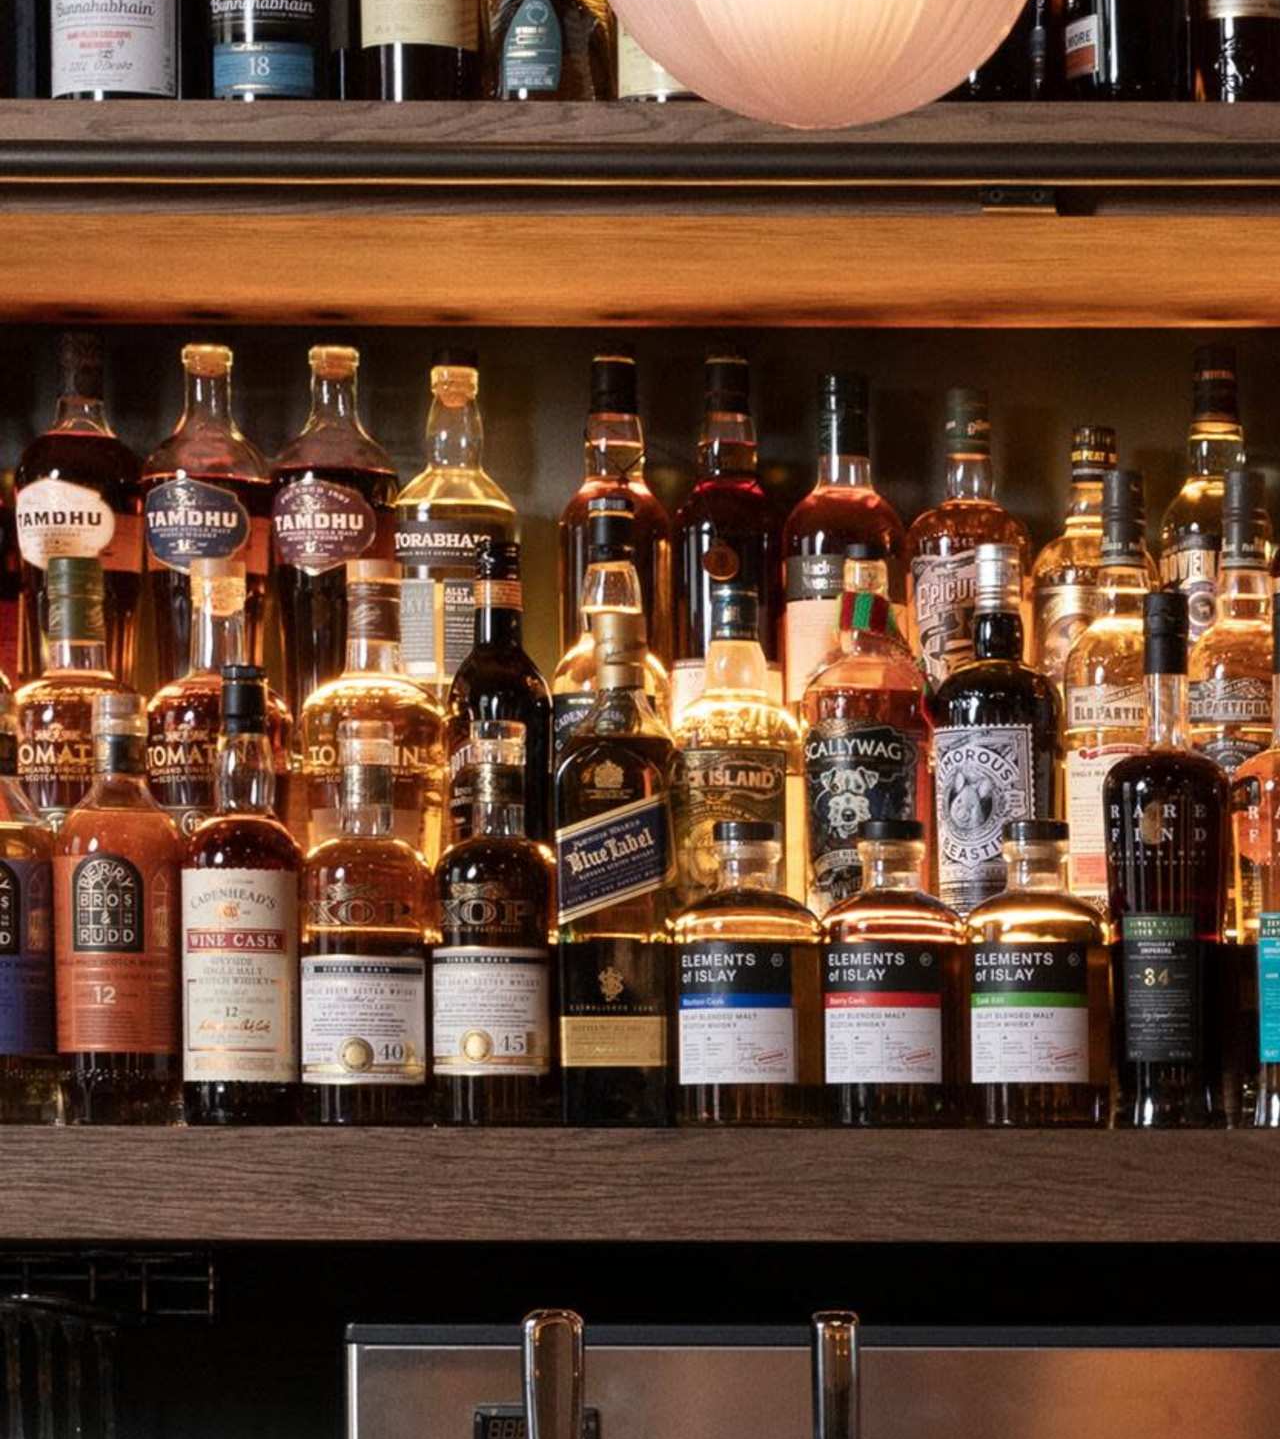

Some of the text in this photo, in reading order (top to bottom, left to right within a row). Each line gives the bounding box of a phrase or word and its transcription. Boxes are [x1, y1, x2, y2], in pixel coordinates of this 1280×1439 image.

[249, 56, 271, 77] 18
[18, 511, 102, 528] TAMDHU
[148, 511, 239, 529] TAMDHU
[273, 513, 364, 531] TAMDHU
[708, 770, 775, 788] ISLAND
[1109, 804, 1207, 820] RARE
[1110, 827, 1207, 843] FIND
[564, 827, 655, 875] Blue Label
[80, 858, 135, 892] BERRY
[79, 891, 132, 908] BROS
[79, 928, 135, 944] RUDD
[189, 932, 279, 949] WINE CASK
[682, 952, 757, 969] ELEMENTS
[828, 952, 906, 967] ELEMENTS
[975, 952, 1054, 967] ELEMENTS
[682, 970, 738, 984] of ISLAY
[828, 968, 886, 983] of ISLAY
[975, 968, 1034, 983] of ISLAY
[1143, 967, 1170, 987] 34
[92, 985, 116, 1005] 12
[224, 1006, 239, 1019] 12
[379, 1043, 404, 1061] 40
